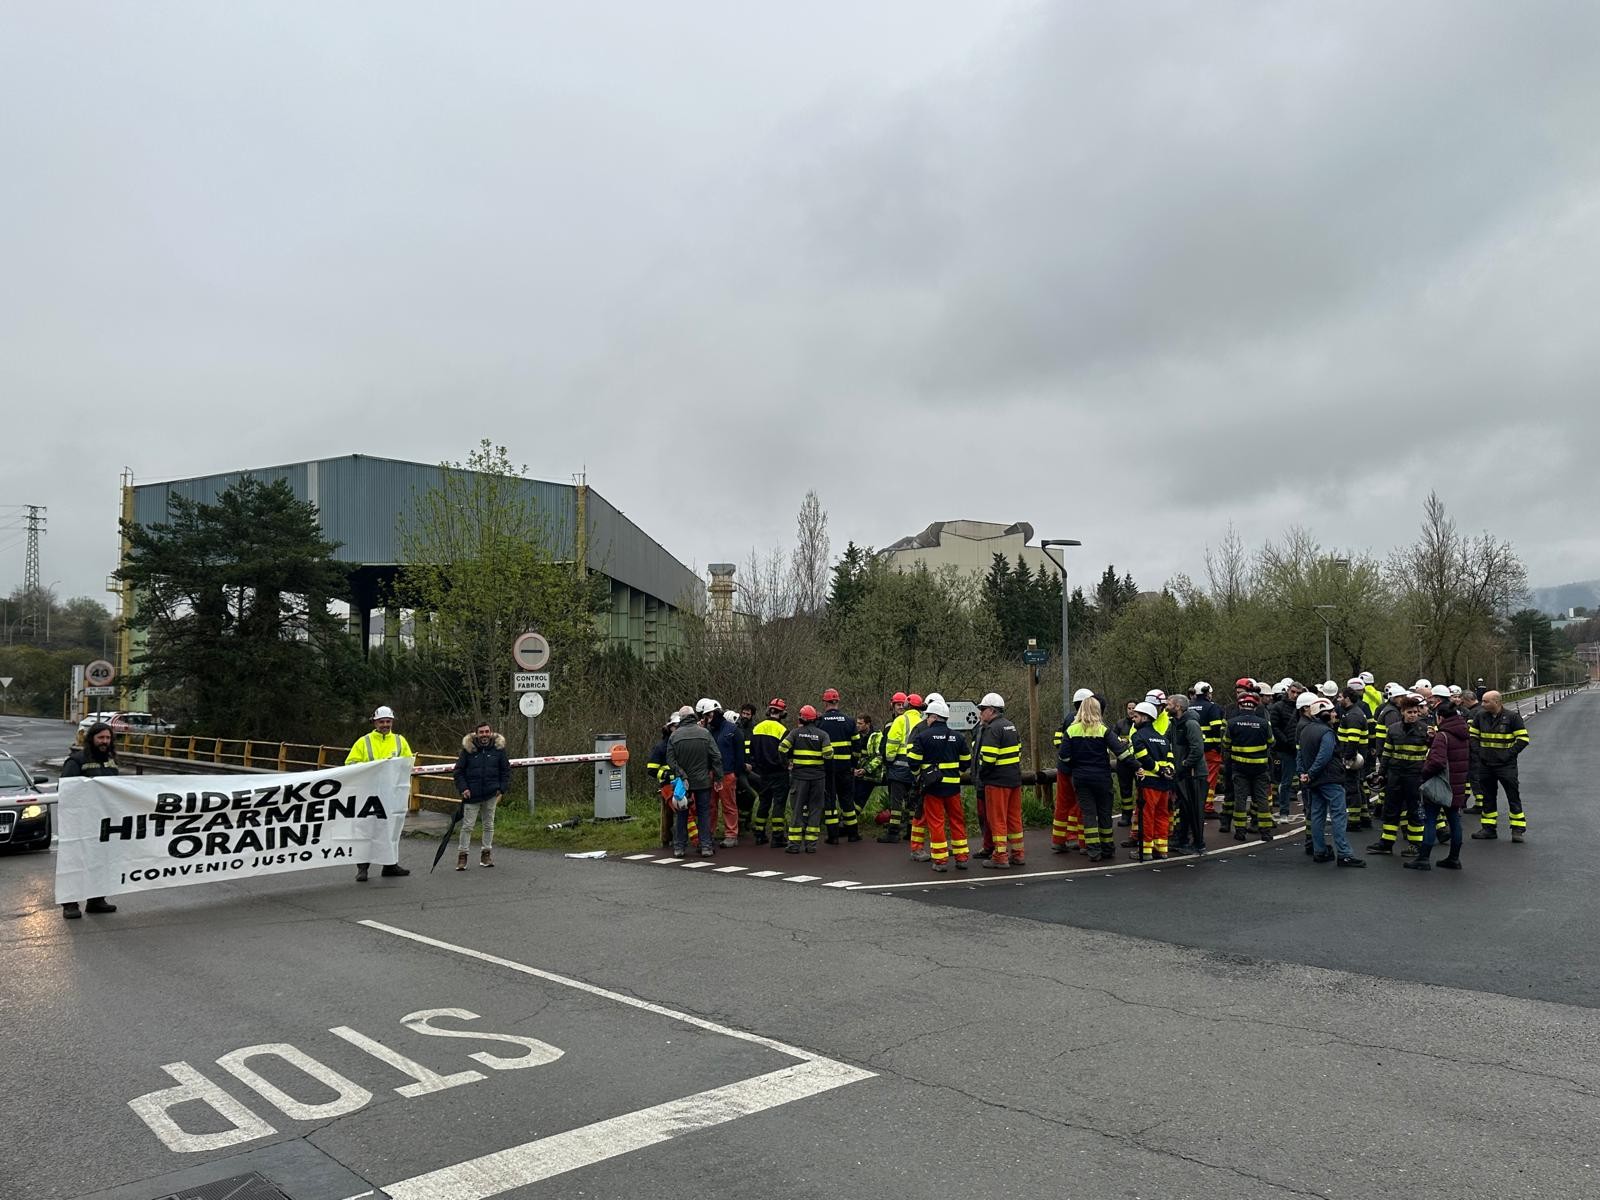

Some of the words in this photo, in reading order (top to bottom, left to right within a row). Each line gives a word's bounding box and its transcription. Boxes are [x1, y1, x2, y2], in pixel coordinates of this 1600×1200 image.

[91, 668, 109, 678] 40
[155, 779, 342, 814] BIDEZKO
[99, 795, 388, 843] HITZARMENA
[168, 823, 323, 859] ORAIN!
[121, 858, 244, 885] ¡CONVENIO
[251, 851, 313, 868] JUSTO
[321, 846, 353, 859] YA!
[127, 1008, 566, 1153] STOP
